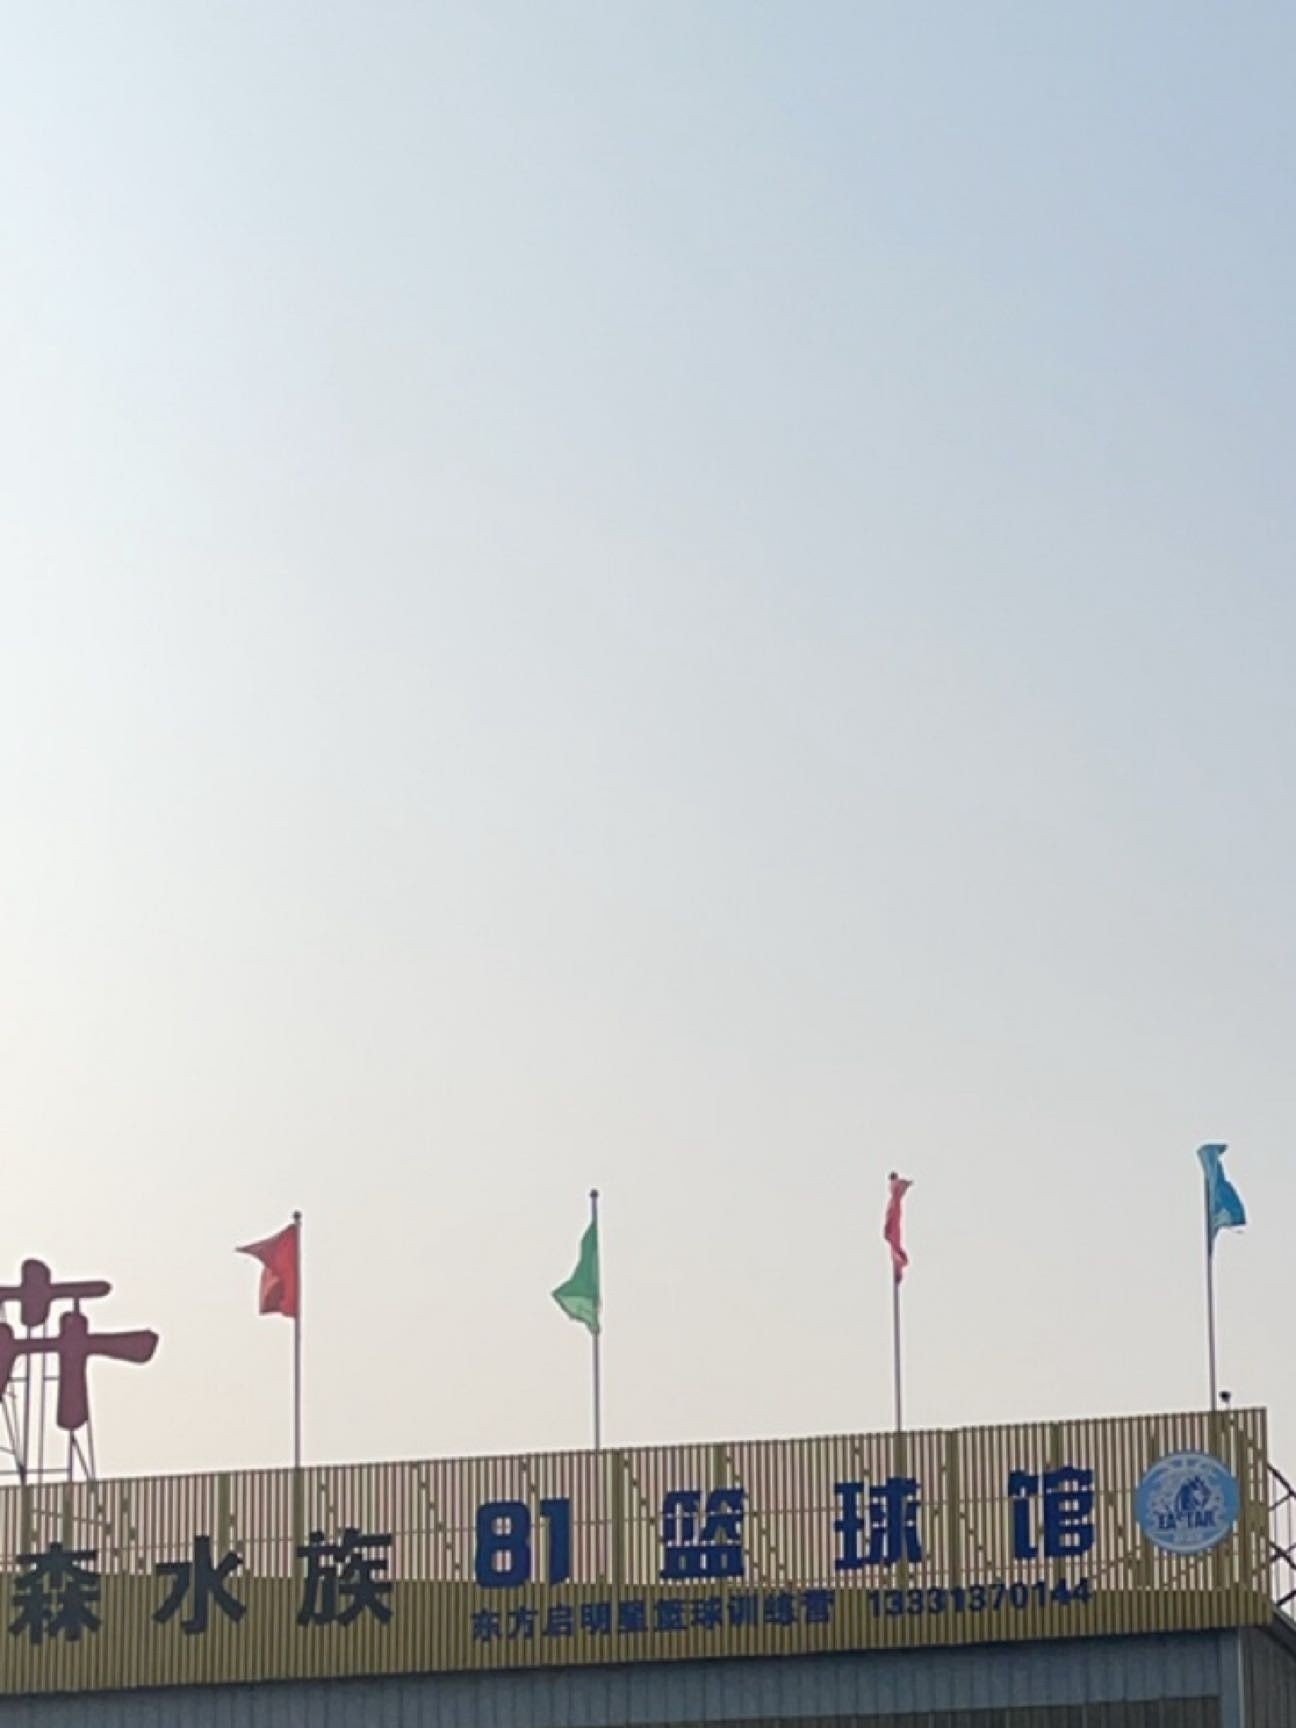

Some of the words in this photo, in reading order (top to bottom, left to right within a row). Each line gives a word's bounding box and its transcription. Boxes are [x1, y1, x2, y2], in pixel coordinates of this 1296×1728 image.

[474, 1464, 1096, 1588] 81篮球馆
[8, 1527, 394, 1644] 森水族
[471, 1587, 835, 1641] 东方启明星篮球训练营
[866, 1577, 1093, 1618] 13331370144
